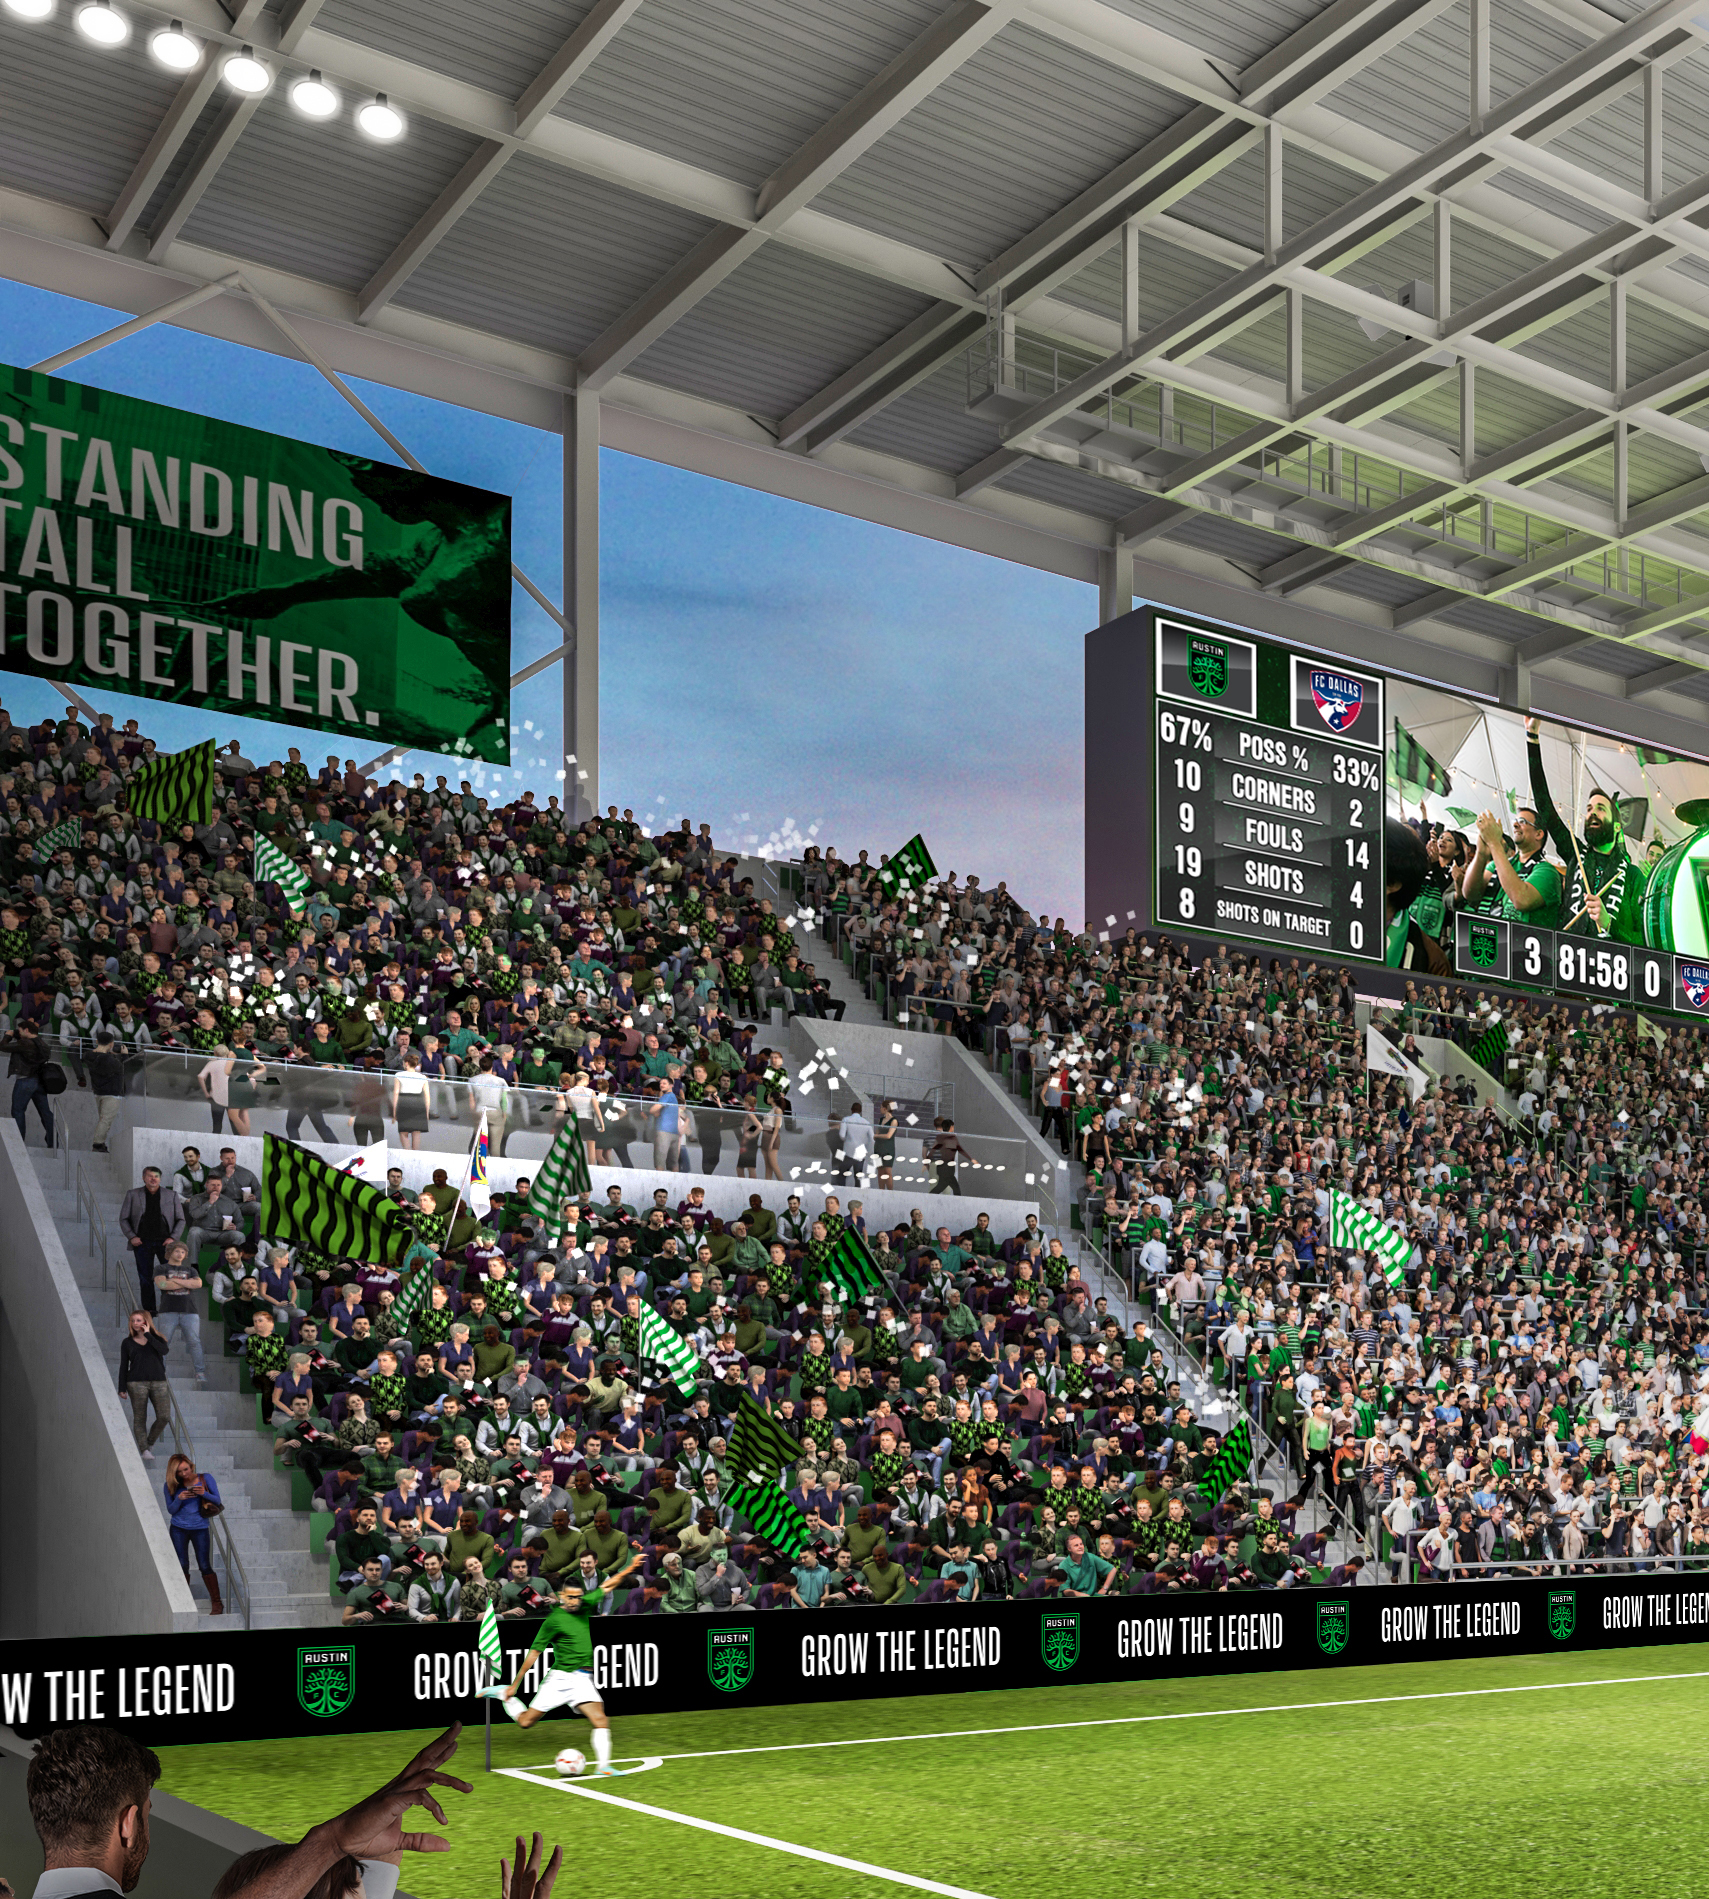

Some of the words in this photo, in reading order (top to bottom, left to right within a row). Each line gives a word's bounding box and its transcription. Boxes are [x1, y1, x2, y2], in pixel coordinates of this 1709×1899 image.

[1192, 641, 1224, 657] AUSTIN
[1315, 675, 1325, 688] FC
[1328, 676, 1359, 698] DALLAS
[1160, 711, 1213, 752] 67%
[1239, 732, 1287, 767] POSS
[1293, 746, 1307, 771] %
[1175, 759, 1200, 791] 10
[1333, 753, 1379, 792] 33%
[1232, 773, 1316, 815] CORNERS
[1180, 803, 1193, 832] 9
[1351, 800, 1362, 827] 2
[1245, 818, 1304, 853] FOULS
[1176, 845, 1200, 876] 19
[1346, 839, 1368, 869] 14
[1244, 859, 1305, 895] SHOTS
[1180, 888, 1194, 918] 8
[1351, 882, 1363, 908] 4
[1218, 901, 1258, 923] SHOTS
[1264, 909, 1279, 927] ON
[1285, 913, 1330, 936] TARGET
[1351, 921, 1362, 948] 0
[1525, 937, 1540, 974] 3
[1560, 945, 1627, 990] 81:58
[1683, 967, 1690, 977] FC
[1646, 961, 1659, 996] 0
[1321, 1606, 1345, 1614] AUSTIN
[1551, 1595, 1573, 1603] AUSTIN
[1604, 1596, 1643, 1629] GROW
[1647, 1594, 1671, 1626] THE
[1047, 1618, 1075, 1628] AUSTIN
[1118, 1618, 1173, 1658] GROW
[1179, 1616, 1212, 1654] THE
[1220, 1613, 1282, 1651] LEGEND
[1382, 1606, 1428, 1642] GROW
[1433, 1604, 1460, 1639] THE
[1467, 1602, 1520, 1637] LEGEND
[714, 1634, 749, 1644] AUSTIN
[802, 1633, 868, 1676] GROW
[876, 1631, 915, 1672] THE
[925, 1627, 1000, 1669] LEGEND
[305, 1652, 348, 1664] AUSTIN
[593, 1642, 659, 1690] GEND
[44, 1669, 105, 1721] THE
[118, 1663, 235, 1717] LEGEND
